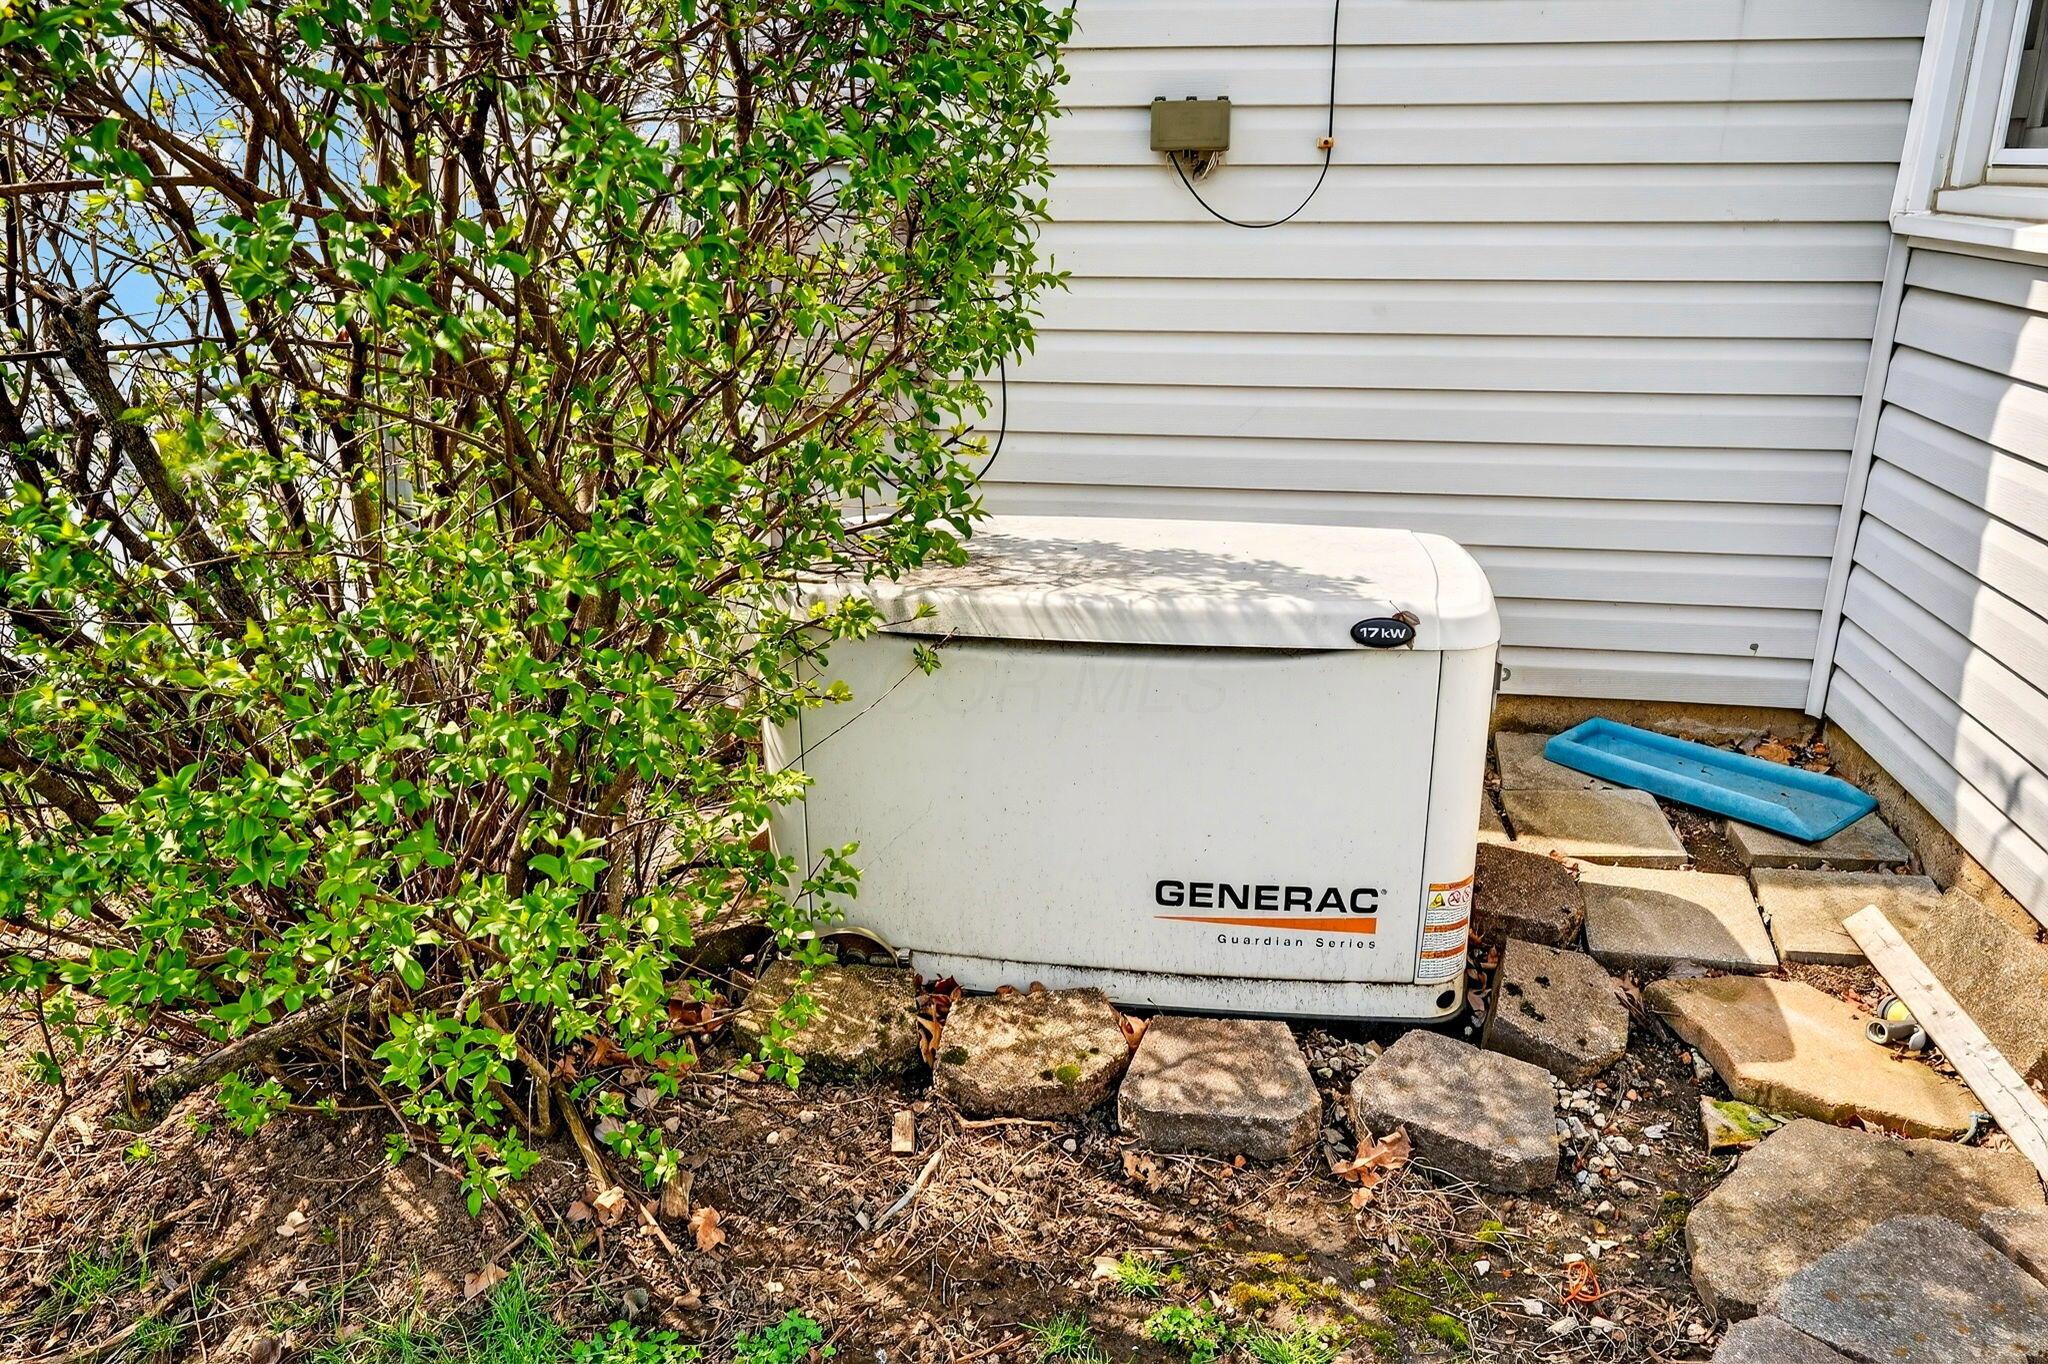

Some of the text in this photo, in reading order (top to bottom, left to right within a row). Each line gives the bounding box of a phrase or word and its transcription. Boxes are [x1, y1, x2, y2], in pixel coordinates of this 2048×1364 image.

[1155, 879, 1379, 914] GENERAC
[1217, 934, 1377, 950] Guardian Series
